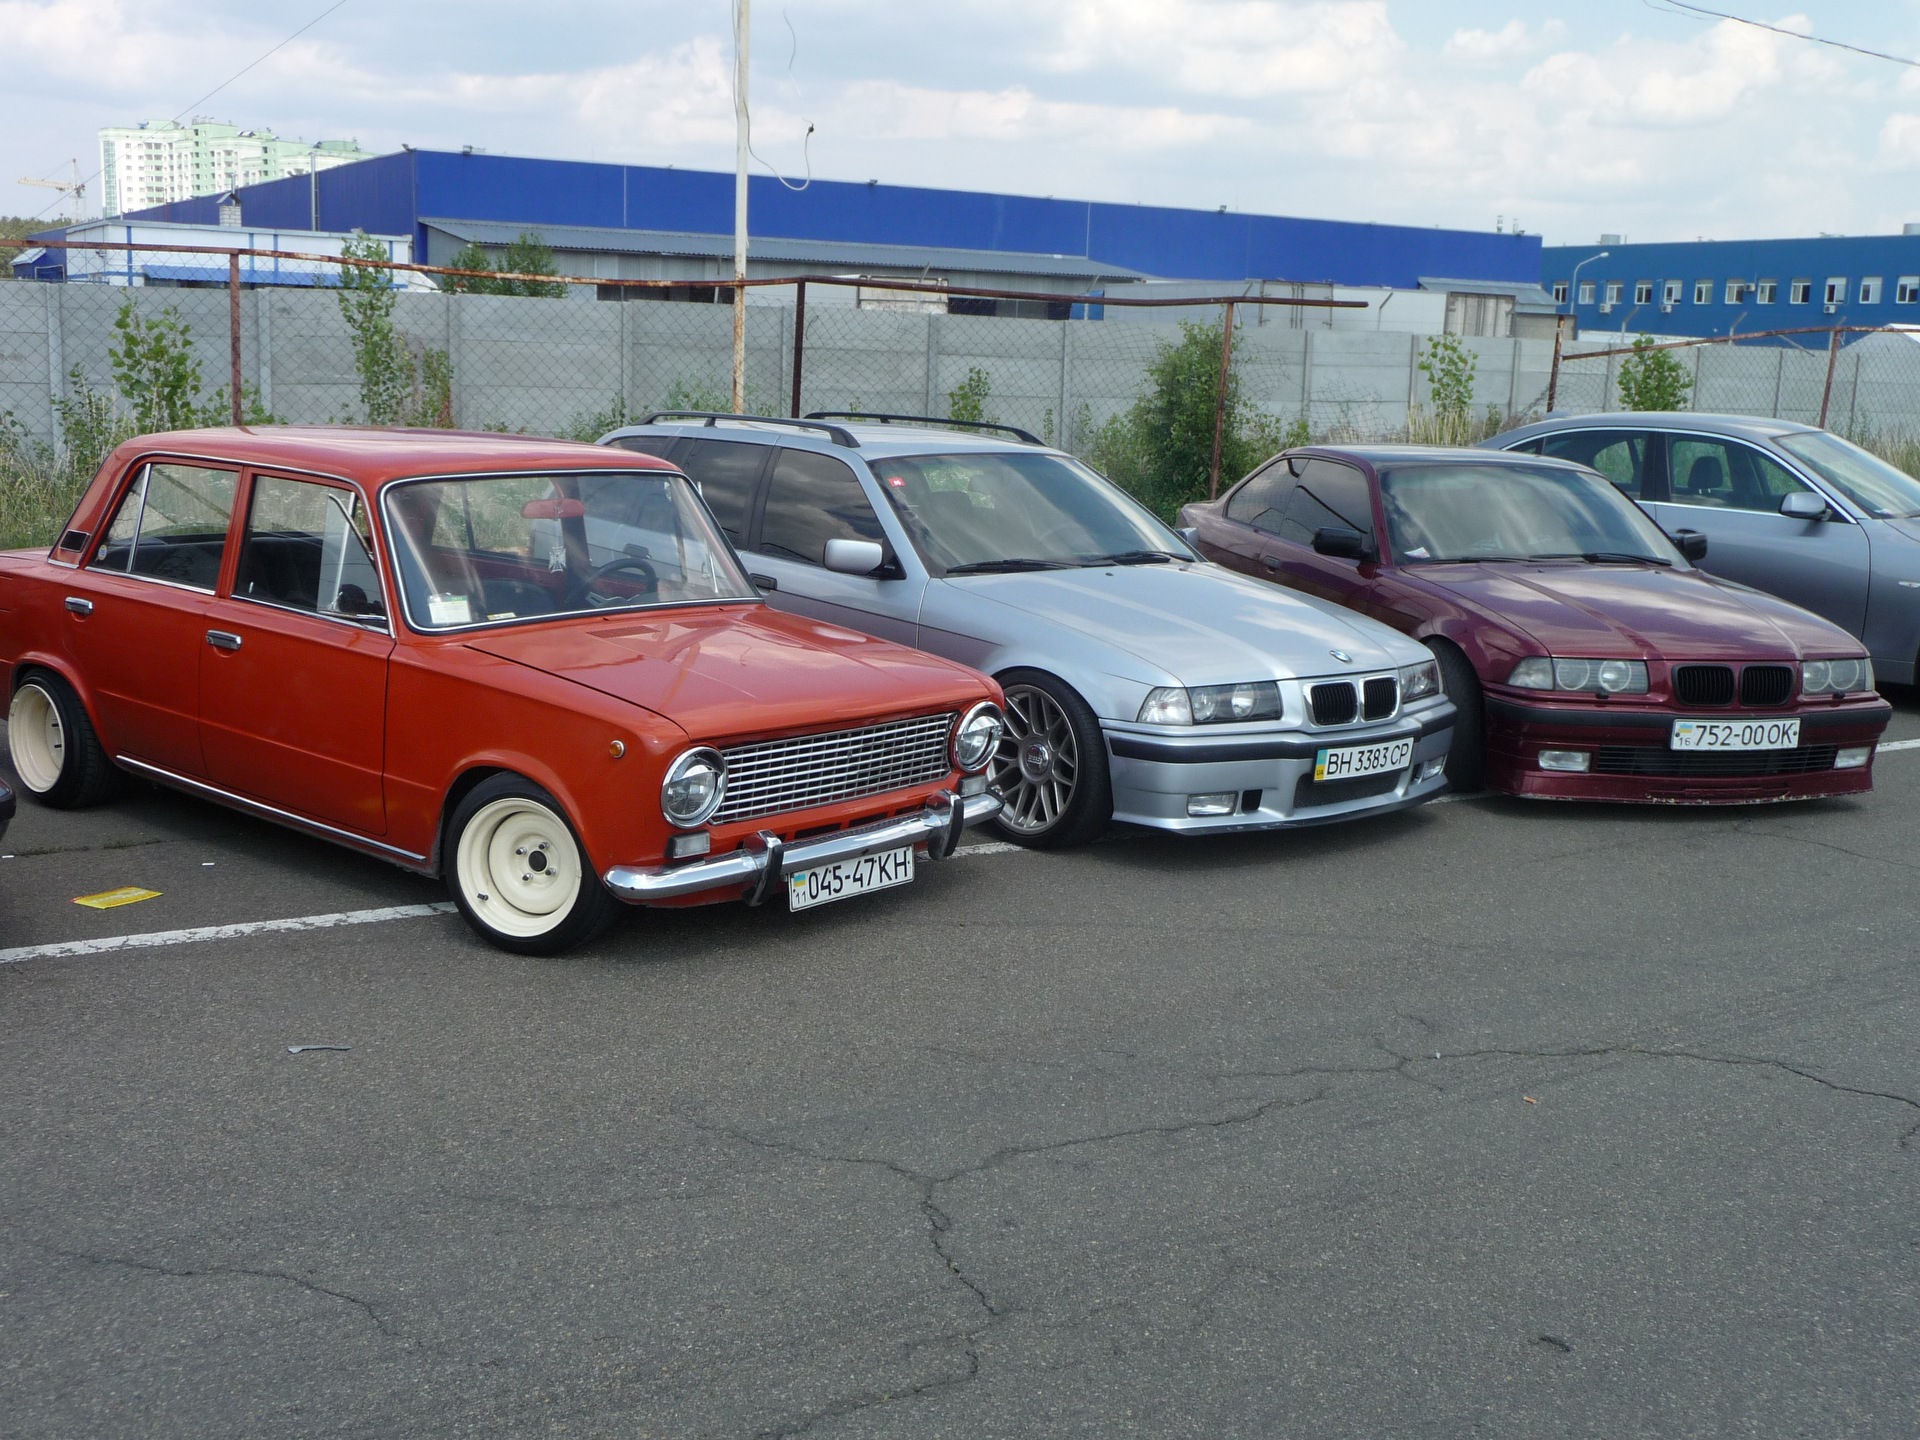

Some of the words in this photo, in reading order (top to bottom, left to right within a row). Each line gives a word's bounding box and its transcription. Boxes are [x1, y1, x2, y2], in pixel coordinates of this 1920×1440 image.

[1679, 738, 1691, 747] 16
[1327, 752, 1352, 775] BH
[1355, 747, 1389, 771] 3383
[1390, 743, 1409, 765] CP
[795, 890, 807, 904] 11
